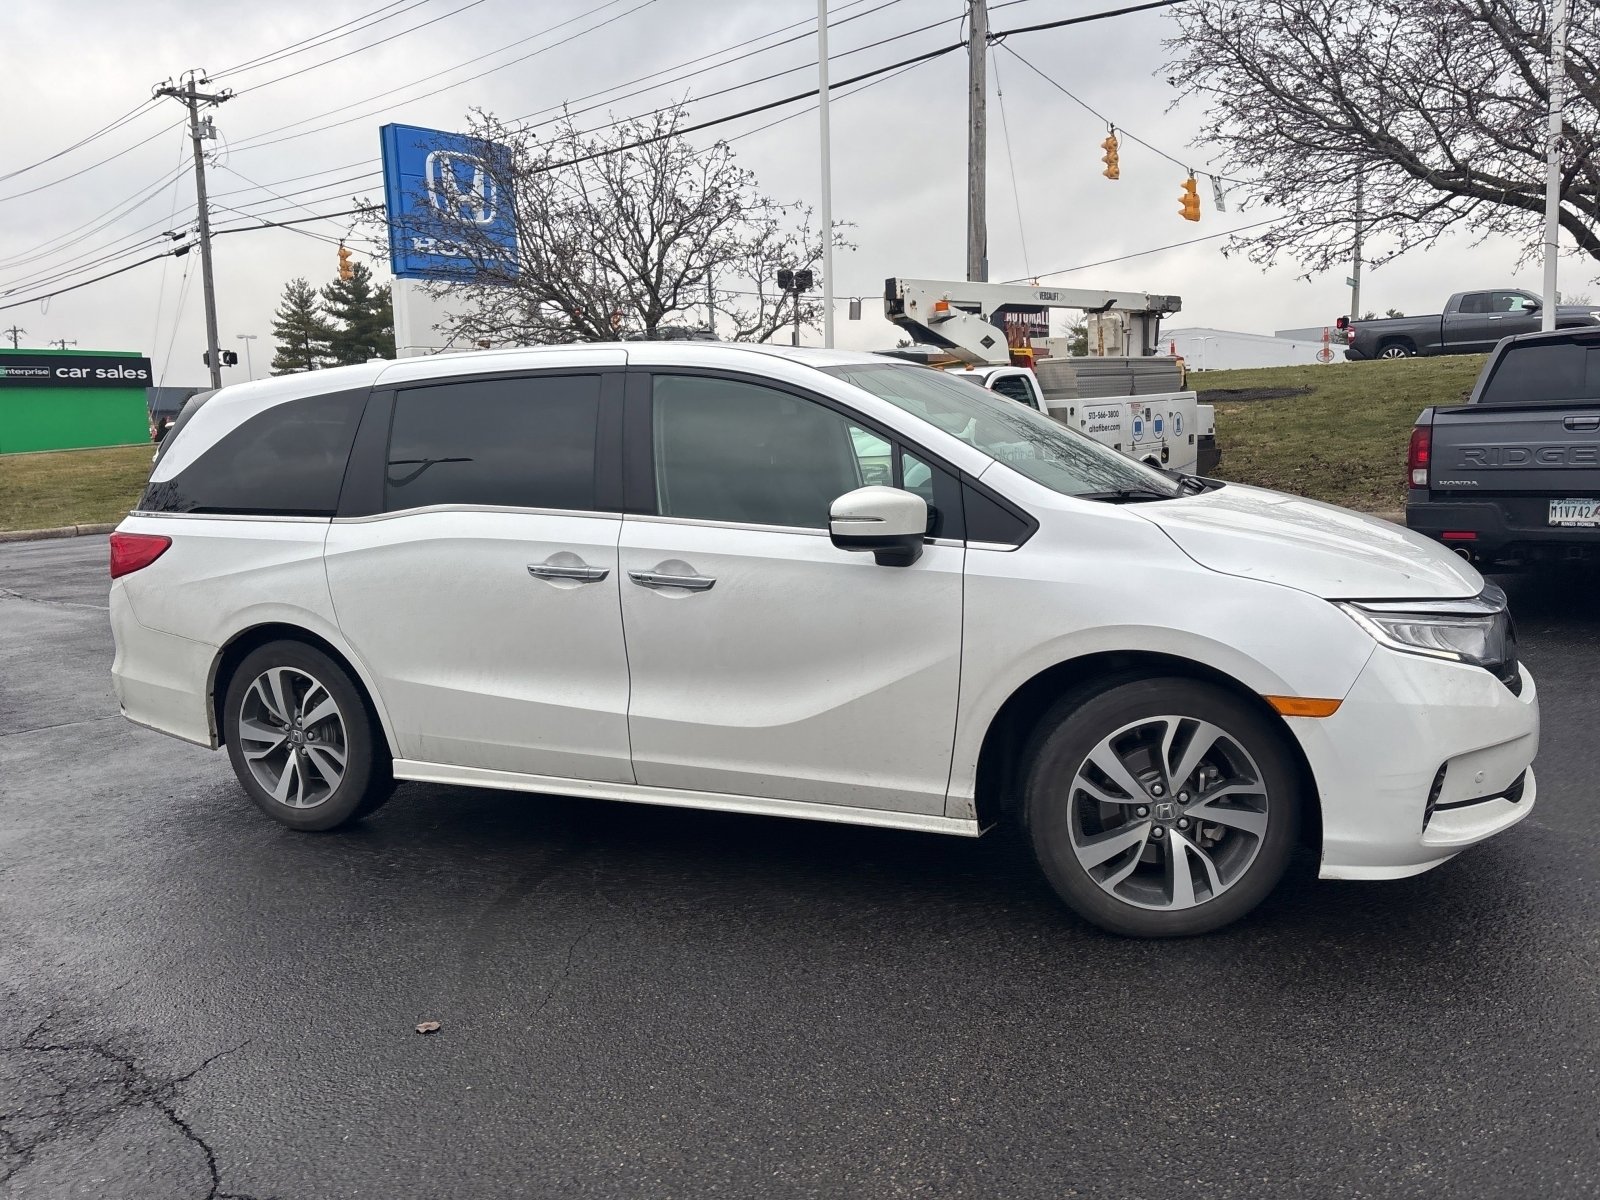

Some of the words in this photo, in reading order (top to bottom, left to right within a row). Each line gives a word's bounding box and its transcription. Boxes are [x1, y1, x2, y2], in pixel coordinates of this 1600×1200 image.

[56, 367, 90, 378] car
[95, 365, 147, 379] sales
[1088, 410, 1119, 419] 513-566-3800
[1089, 424, 1120, 432] altafiber.com
[1457, 446, 1598, 466] RIDGE
[1551, 505, 1591, 518] M1V742
